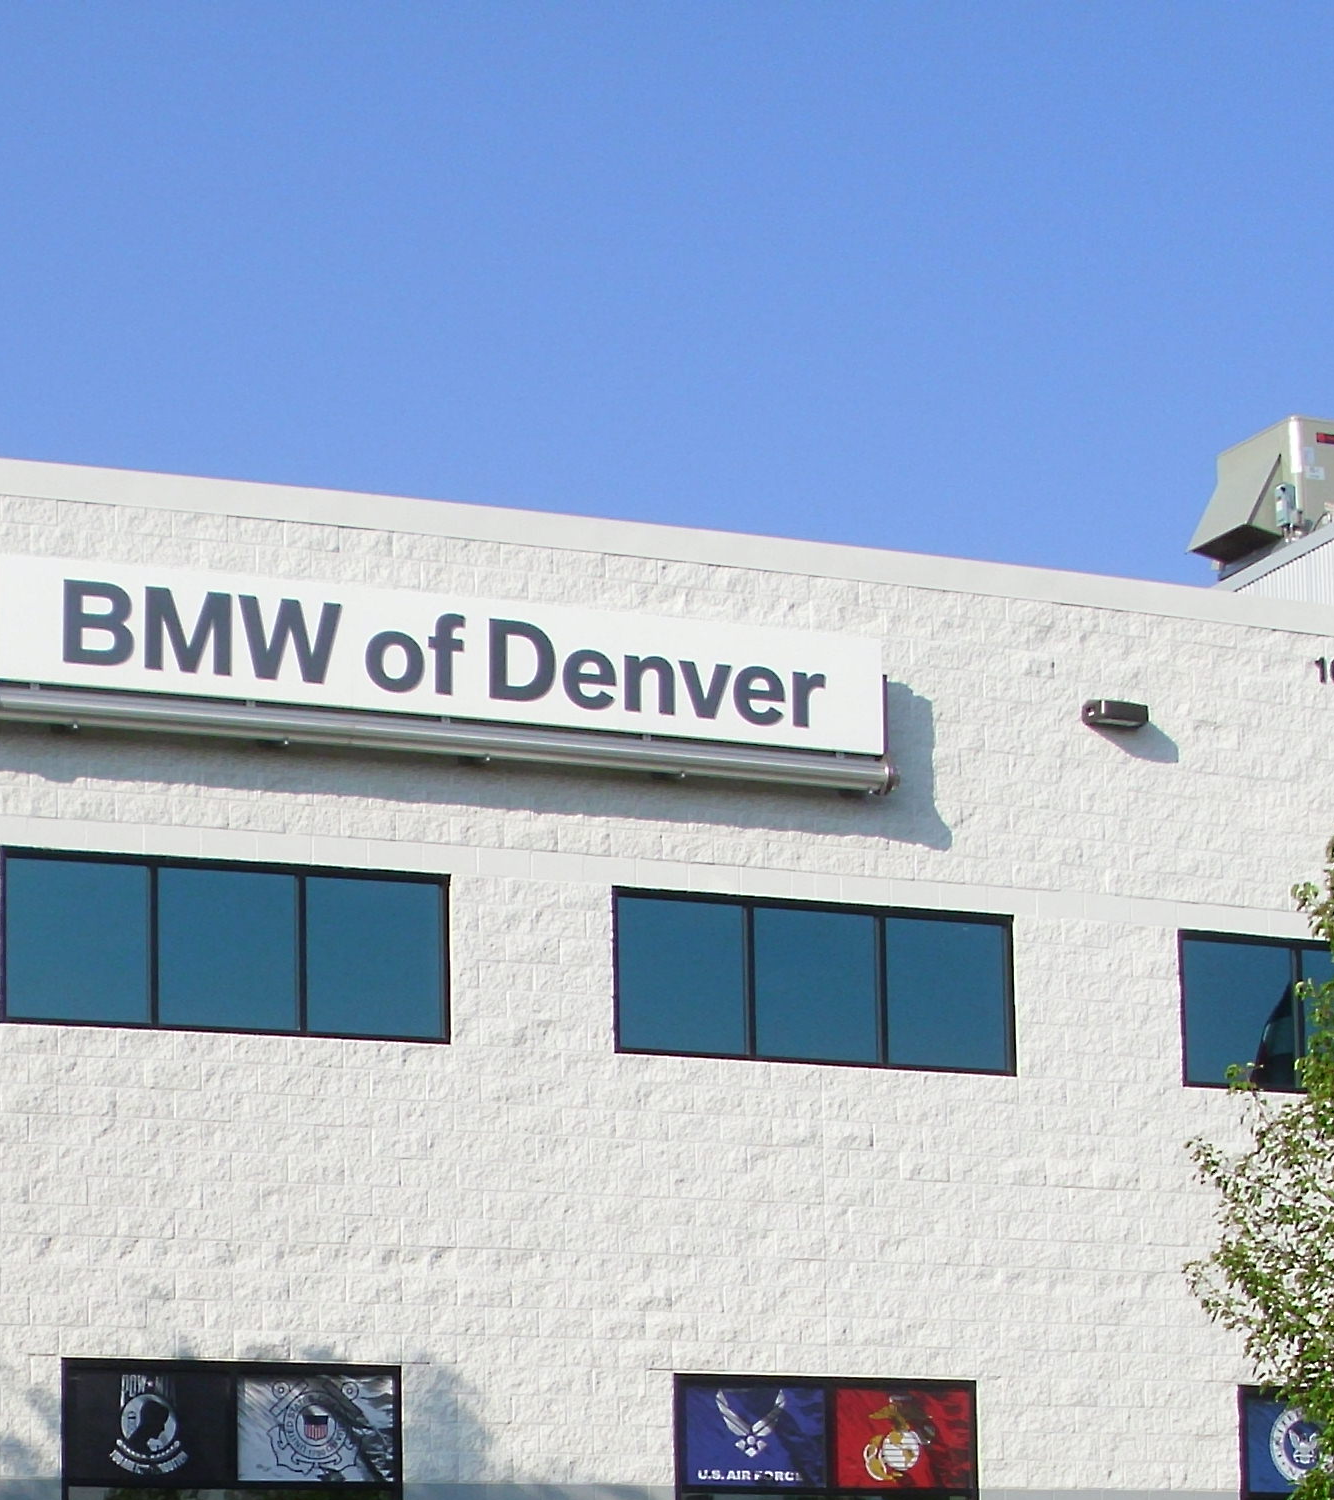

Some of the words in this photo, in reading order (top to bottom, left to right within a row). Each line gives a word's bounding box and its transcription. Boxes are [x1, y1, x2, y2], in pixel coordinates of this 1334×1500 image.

[63, 579, 342, 684] BMW
[365, 613, 466, 696] of
[489, 618, 826, 728] Denver
[697, 1469, 724, 1481] U.S.
[726, 1469, 751, 1482] AIR
